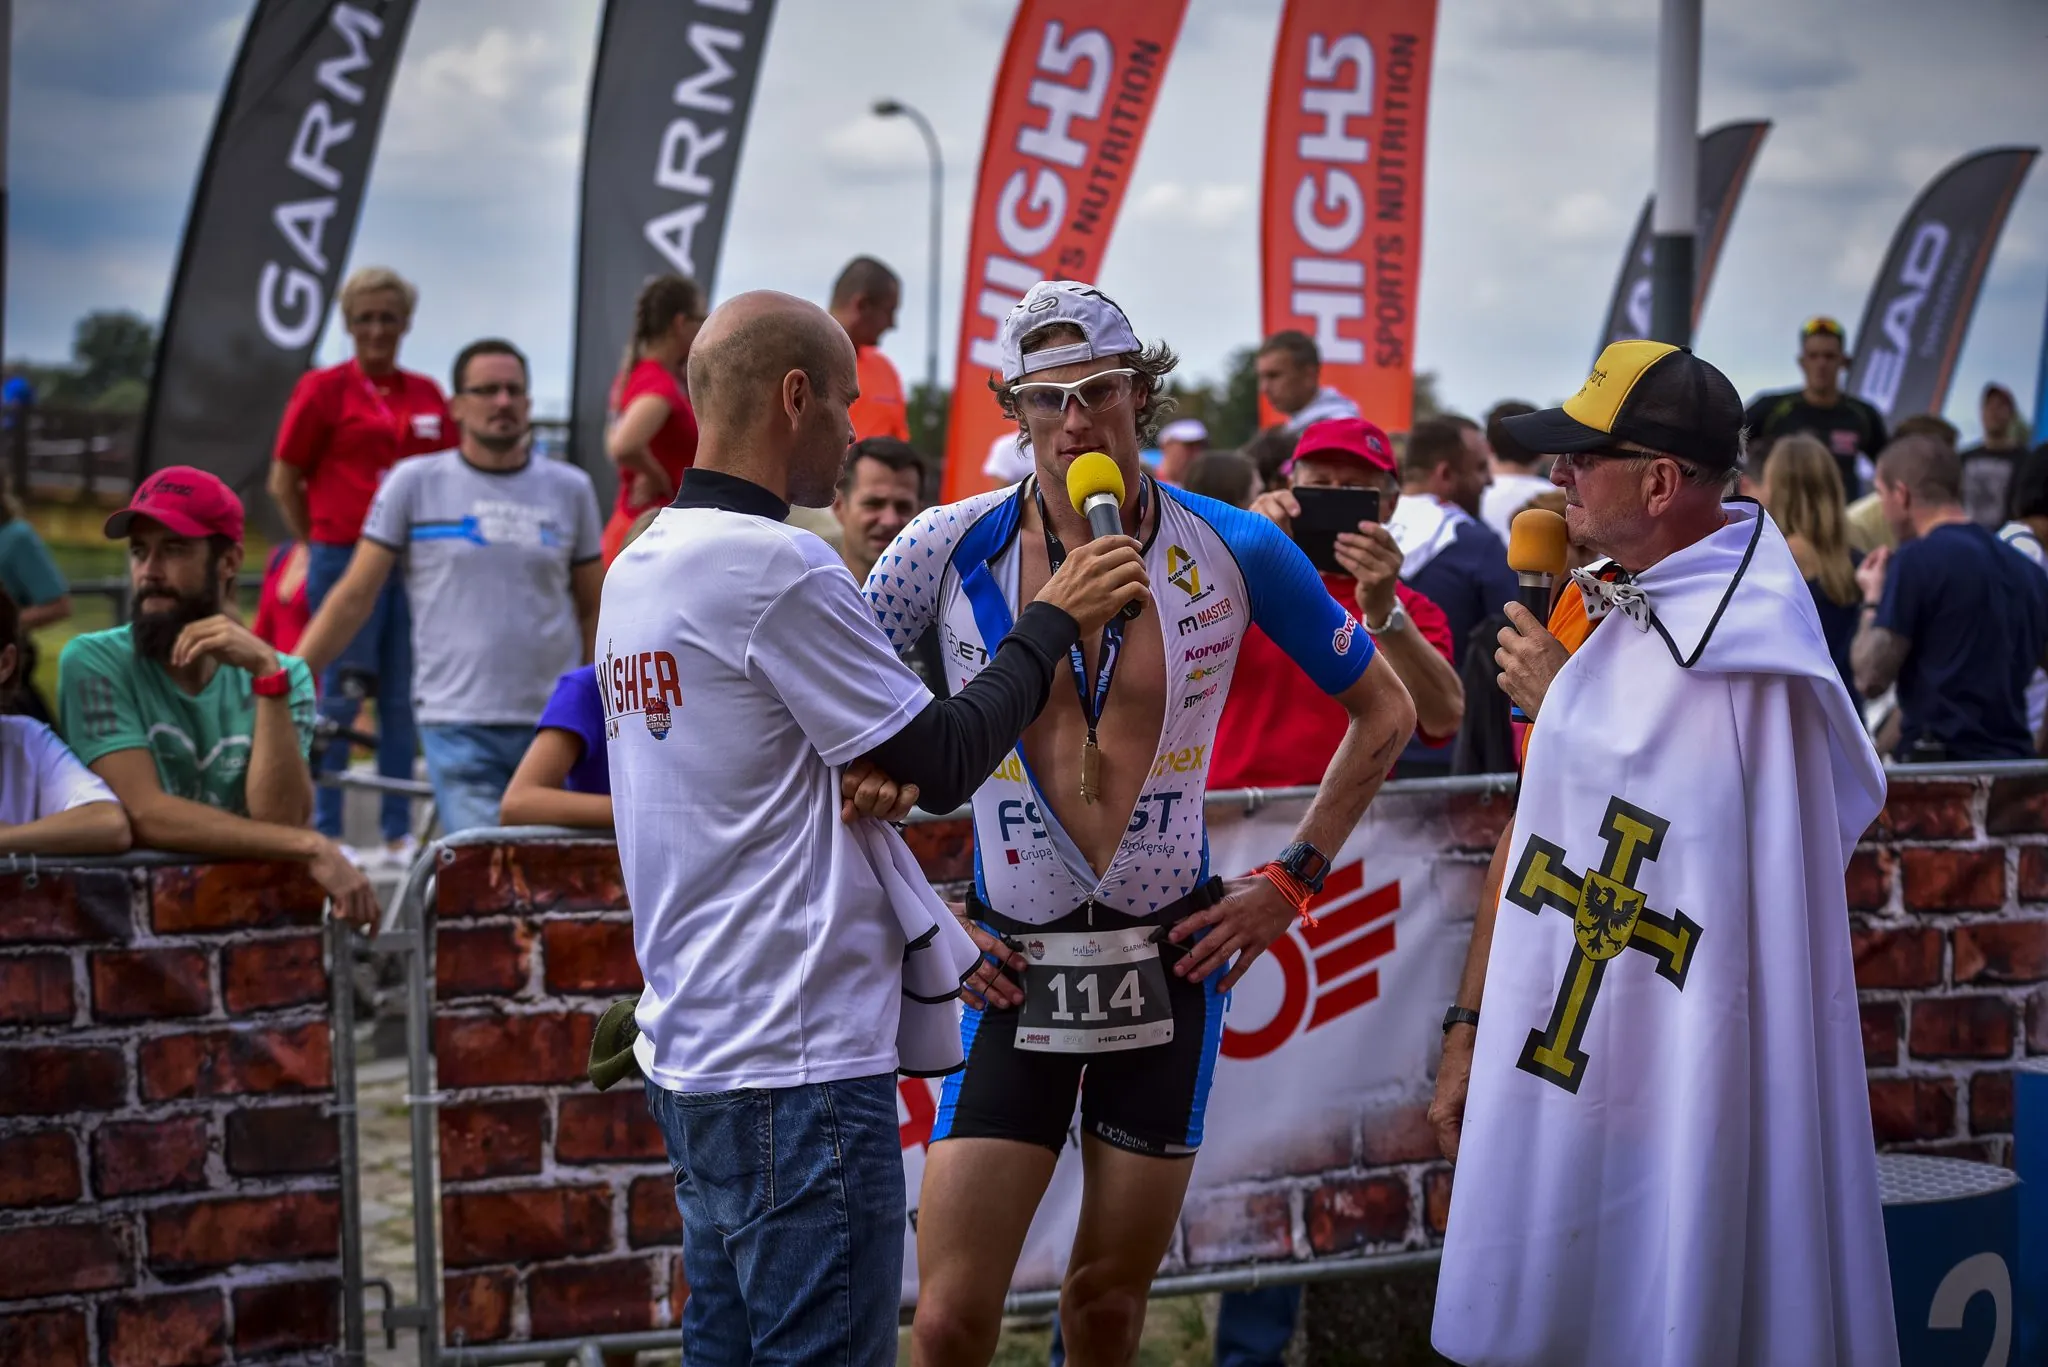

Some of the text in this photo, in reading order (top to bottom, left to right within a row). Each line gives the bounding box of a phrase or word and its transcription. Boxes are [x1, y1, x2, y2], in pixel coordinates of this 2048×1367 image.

[643, 0, 752, 276] ARMI
[1072, 38, 1161, 235] NUTRITION
[1291, 32, 1376, 364] HIGH5
[1375, 33, 1419, 368] SPORTS NUTRITION
[1860, 222, 1949, 415] EAD
[1197, 598, 1233, 624] MASTER
[1184, 637, 1234, 662] Korona
[597, 651, 682, 717] NISHER
[1020, 839, 1175, 862] Grupa Brokerska
[1048, 969, 1145, 1021] 114
[1098, 1034, 1136, 1043] HEAD
